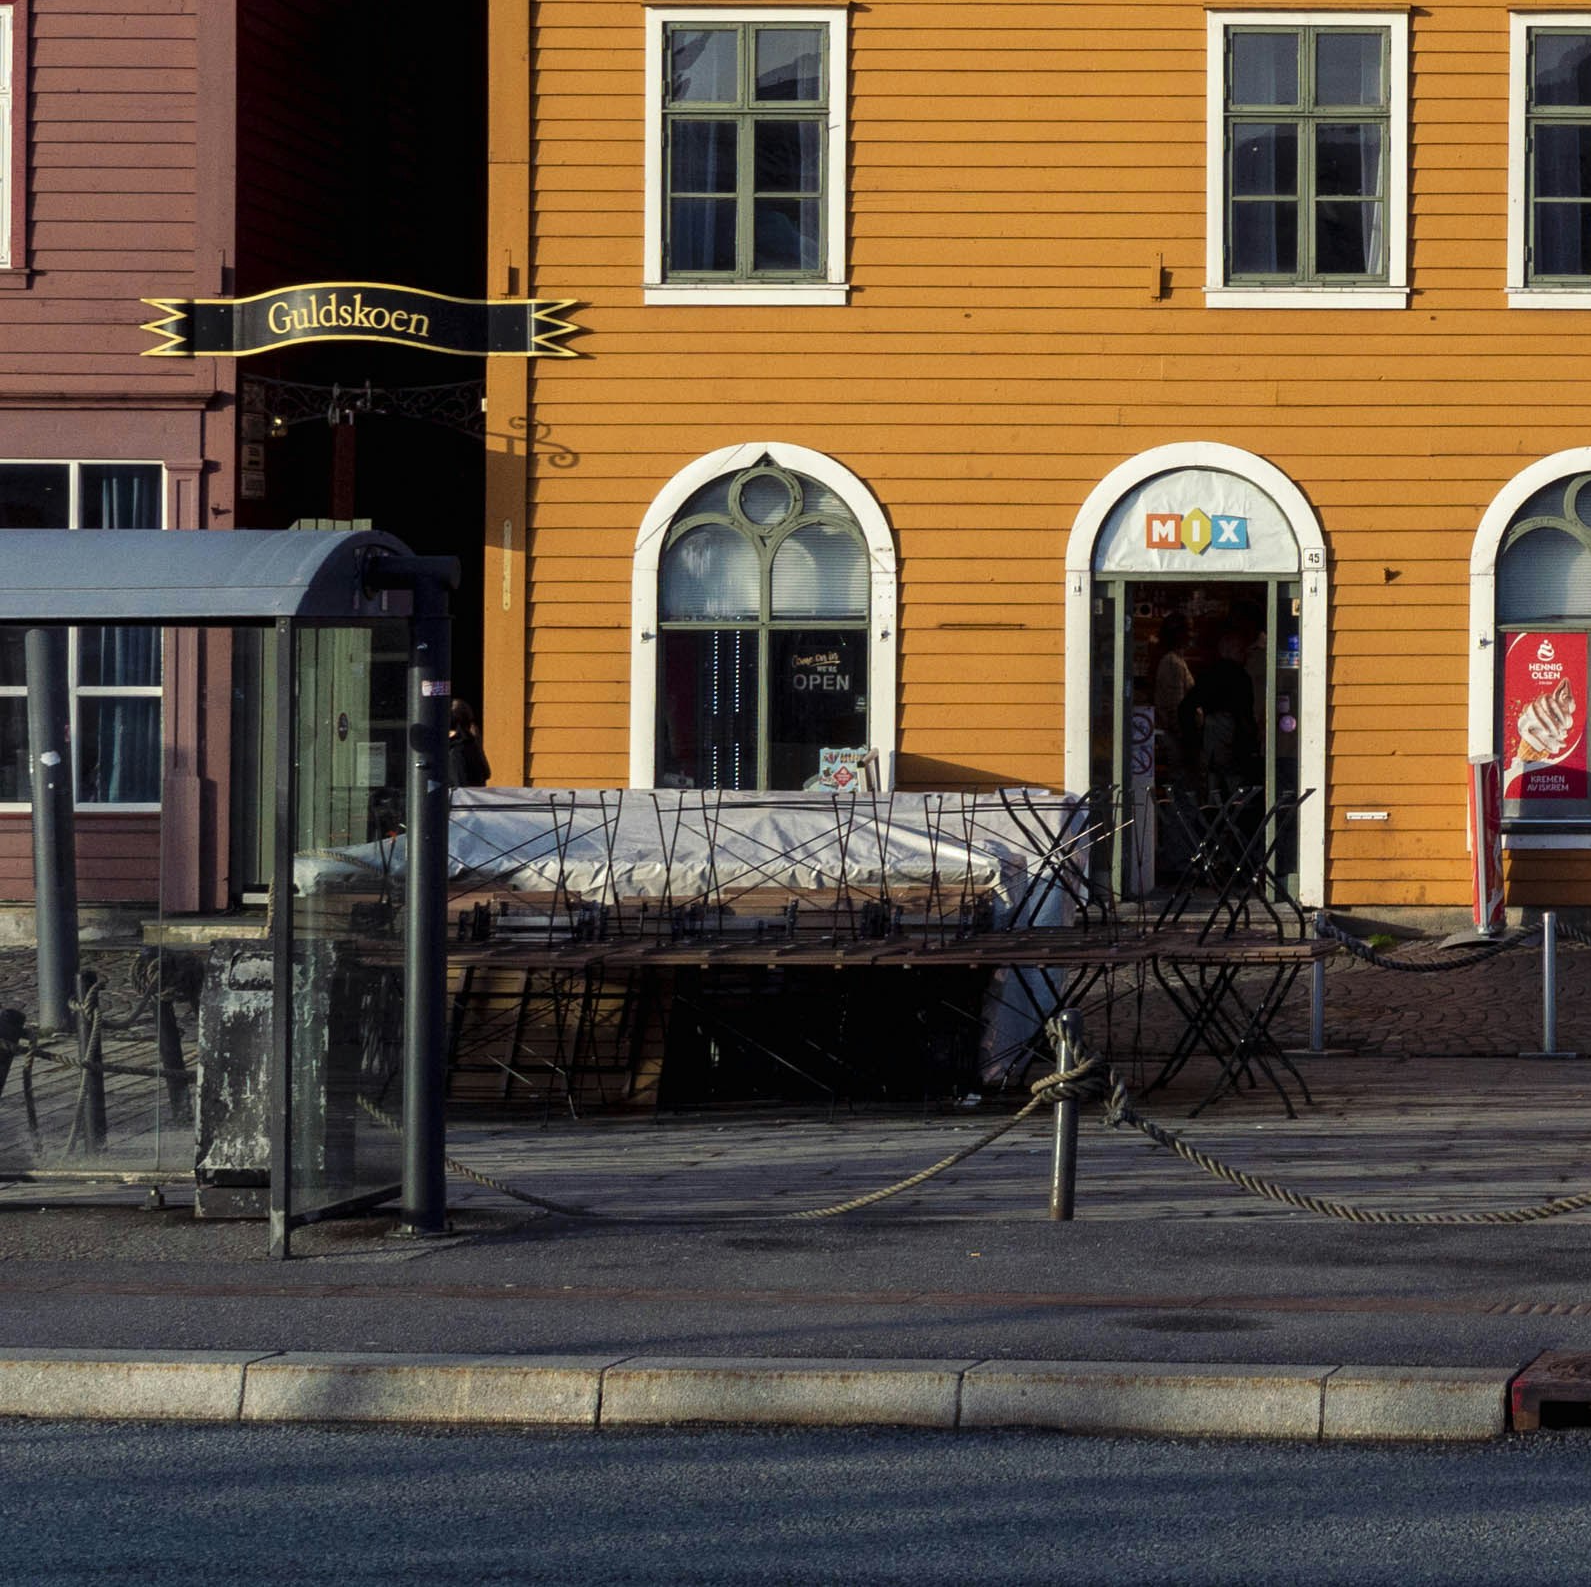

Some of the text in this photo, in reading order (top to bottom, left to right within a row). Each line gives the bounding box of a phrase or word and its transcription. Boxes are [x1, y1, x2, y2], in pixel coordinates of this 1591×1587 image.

[267, 293, 430, 337] Guldskoen
[1151, 520, 1240, 543] MIX
[1308, 553, 1320, 563] 45
[1528, 663, 1563, 672] HENNIG
[1531, 671, 1561, 680] OLSEN
[793, 674, 850, 691] OPEN
[1530, 775, 1565, 783] KREMEN
[1527, 783, 1569, 792] AV ISKREM
